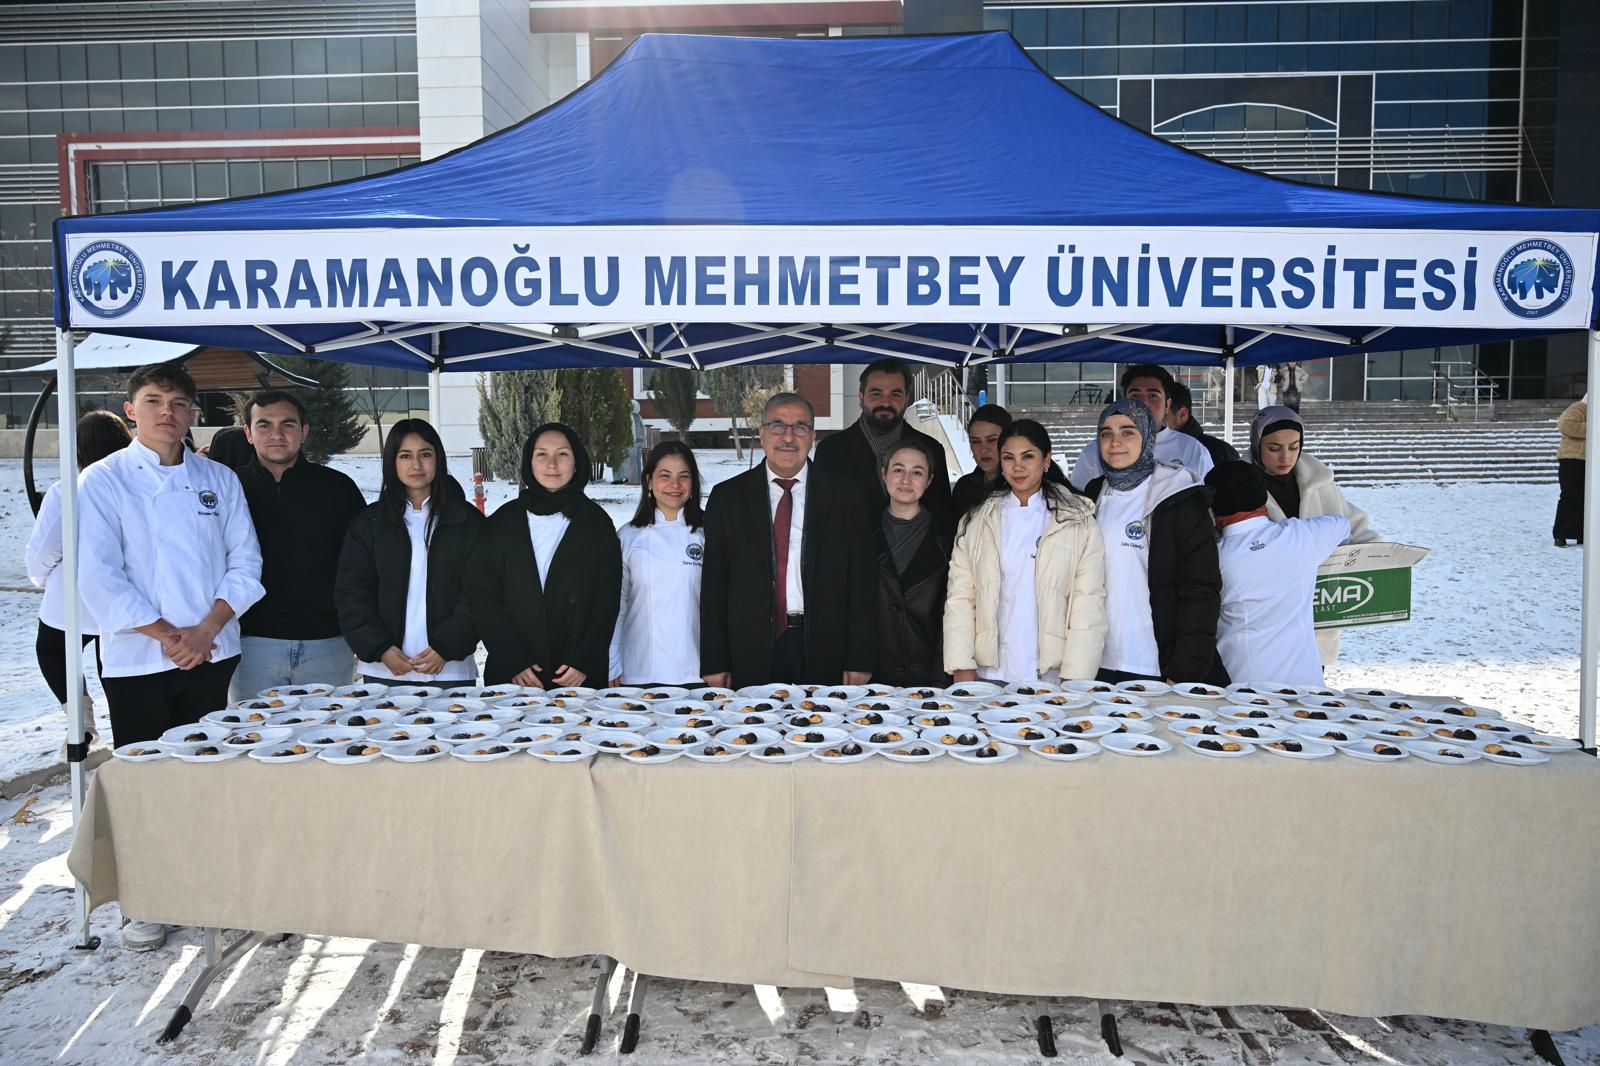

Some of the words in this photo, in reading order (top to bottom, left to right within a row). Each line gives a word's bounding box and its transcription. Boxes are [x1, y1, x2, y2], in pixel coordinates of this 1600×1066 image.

[86, 242, 129, 254] MEHMETBEY
[1516, 241, 1560, 254] MEHMETBEY
[161, 243, 620, 311] KARAMANOĞLU
[644, 254, 1026, 308] MEHMETBEY
[1047, 243, 1478, 312] ÜNİVERSİTESİ
